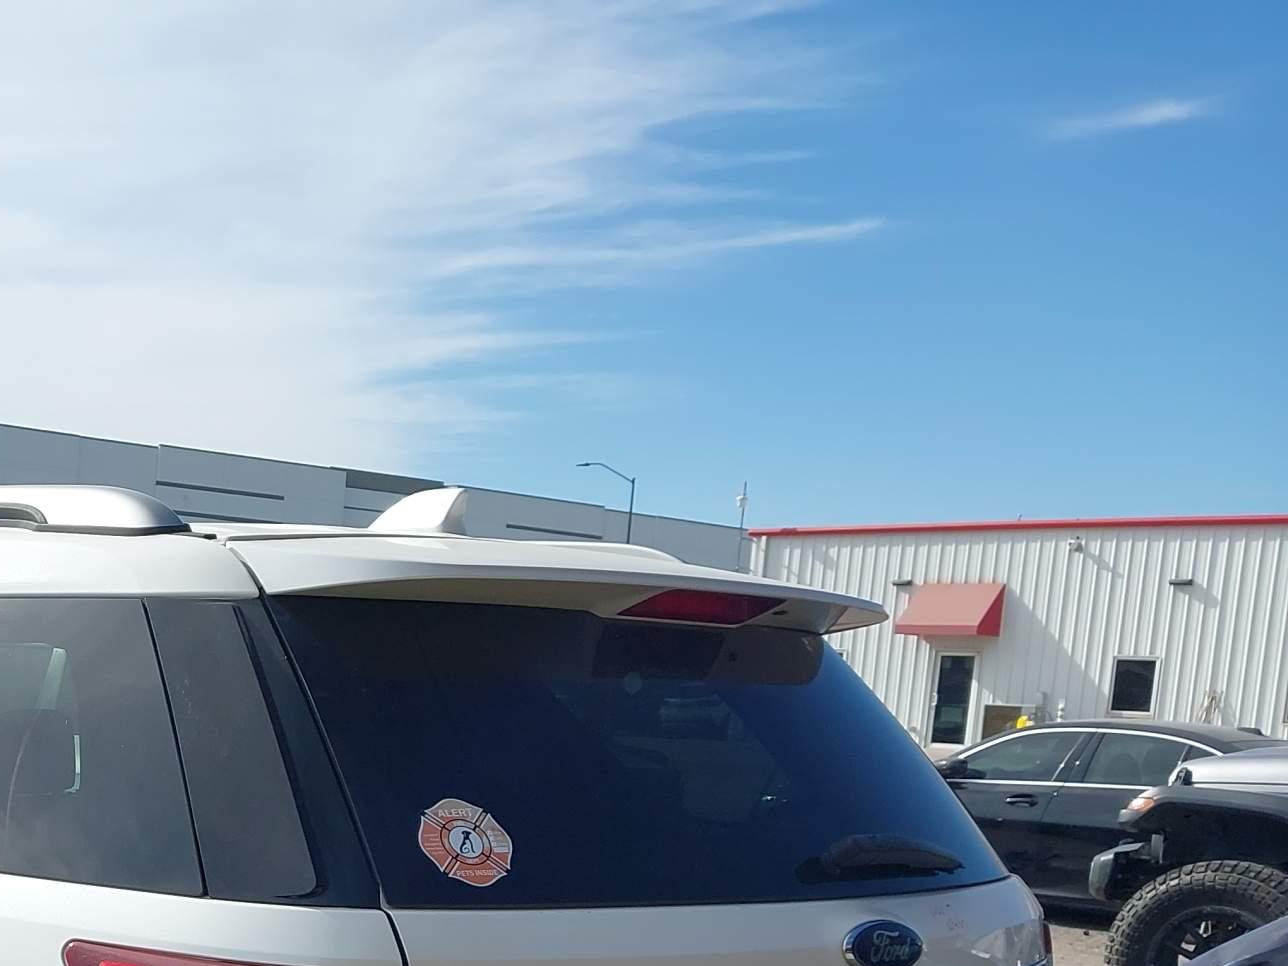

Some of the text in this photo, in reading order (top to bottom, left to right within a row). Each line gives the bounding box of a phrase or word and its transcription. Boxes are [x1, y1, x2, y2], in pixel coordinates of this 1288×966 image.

[438, 807, 473, 818] ALERT
[456, 868, 498, 877] PETS INSIDE
[870, 929, 911, 963] Ford
